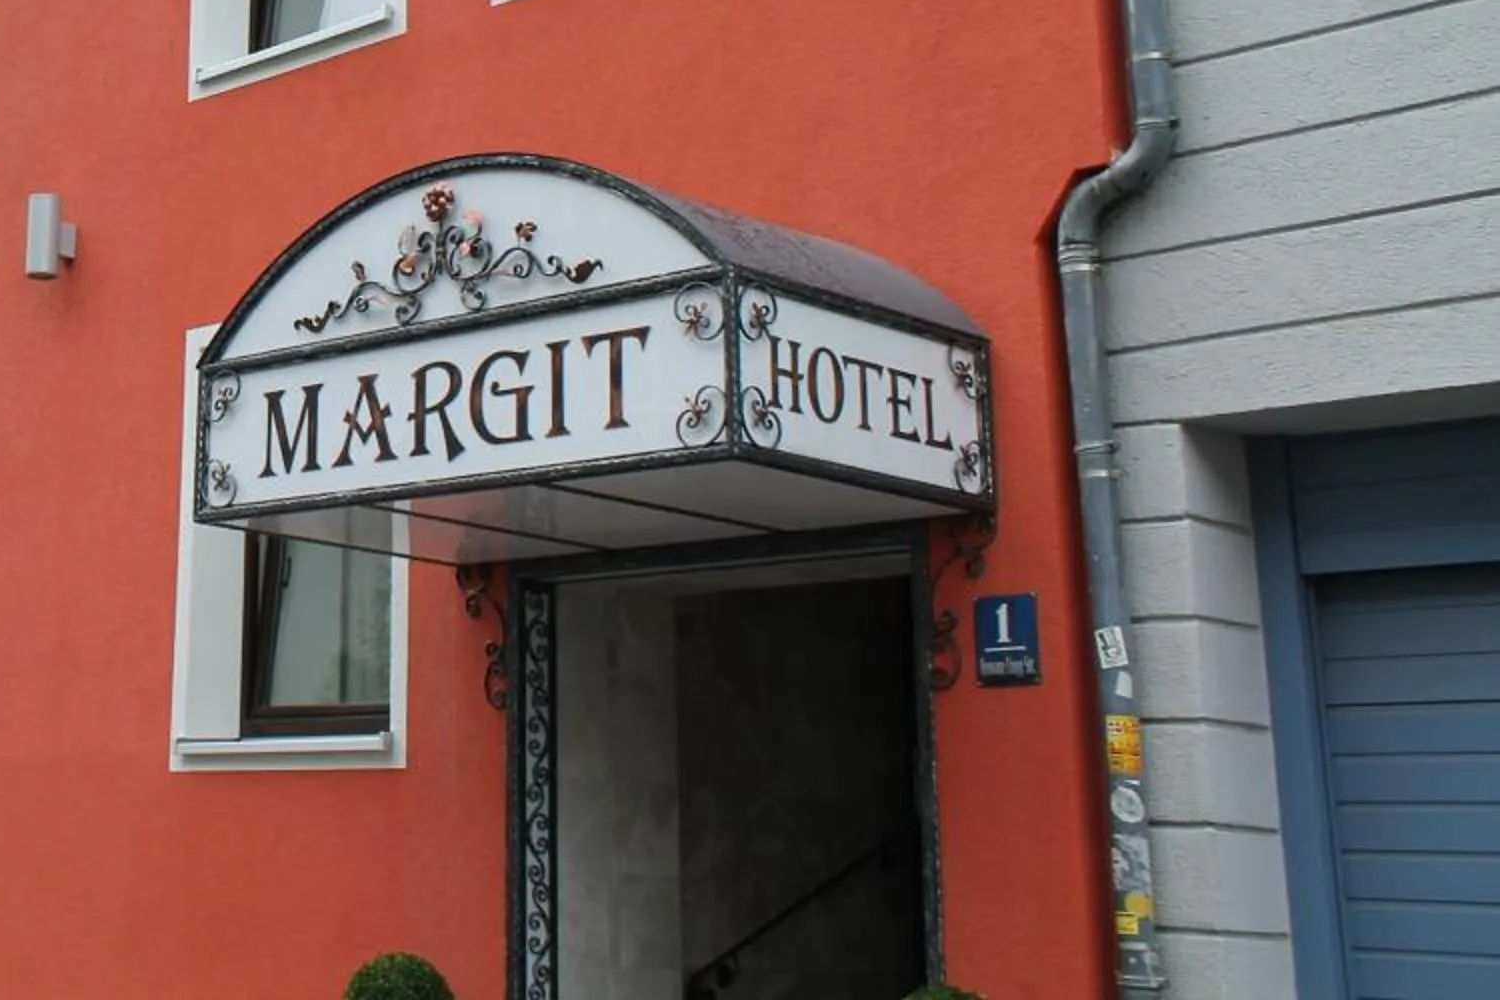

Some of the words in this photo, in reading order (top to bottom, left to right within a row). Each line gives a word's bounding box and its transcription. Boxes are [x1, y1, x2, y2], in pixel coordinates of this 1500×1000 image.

[257, 325, 652, 481] MARGIT
[765, 334, 955, 452] HOTEL
[995, 603, 1012, 644] 1
